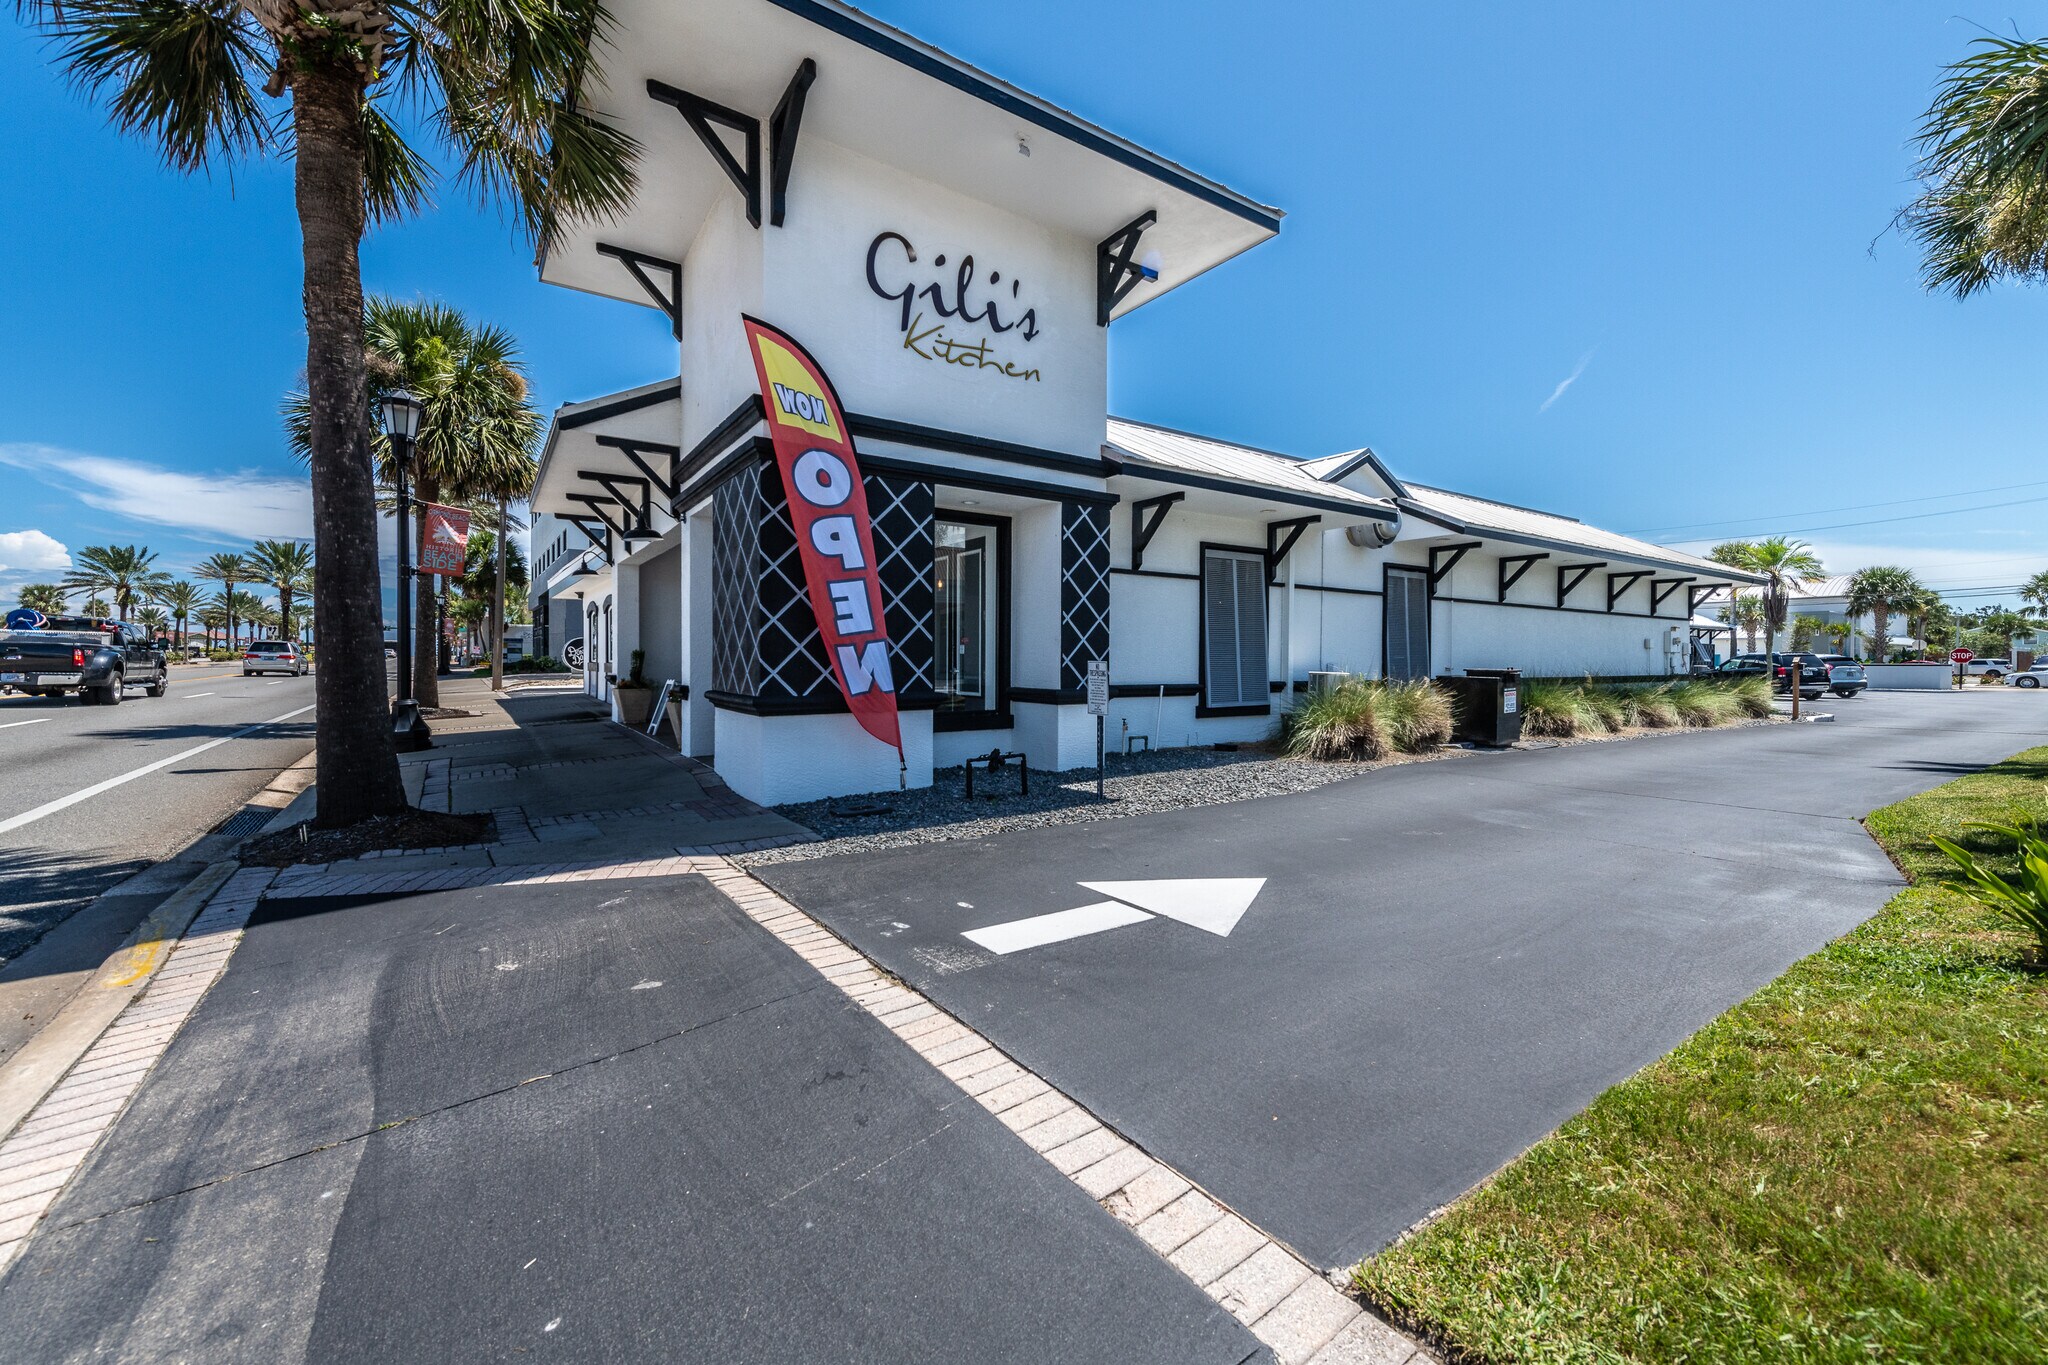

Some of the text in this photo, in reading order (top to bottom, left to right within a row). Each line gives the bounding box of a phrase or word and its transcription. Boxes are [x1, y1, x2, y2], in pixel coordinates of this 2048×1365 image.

[865, 231, 1040, 342] Gili's
[903, 312, 1041, 382] Kitchen
[423, 558, 456, 570] SIDE
[424, 550, 462, 562] BEACH
